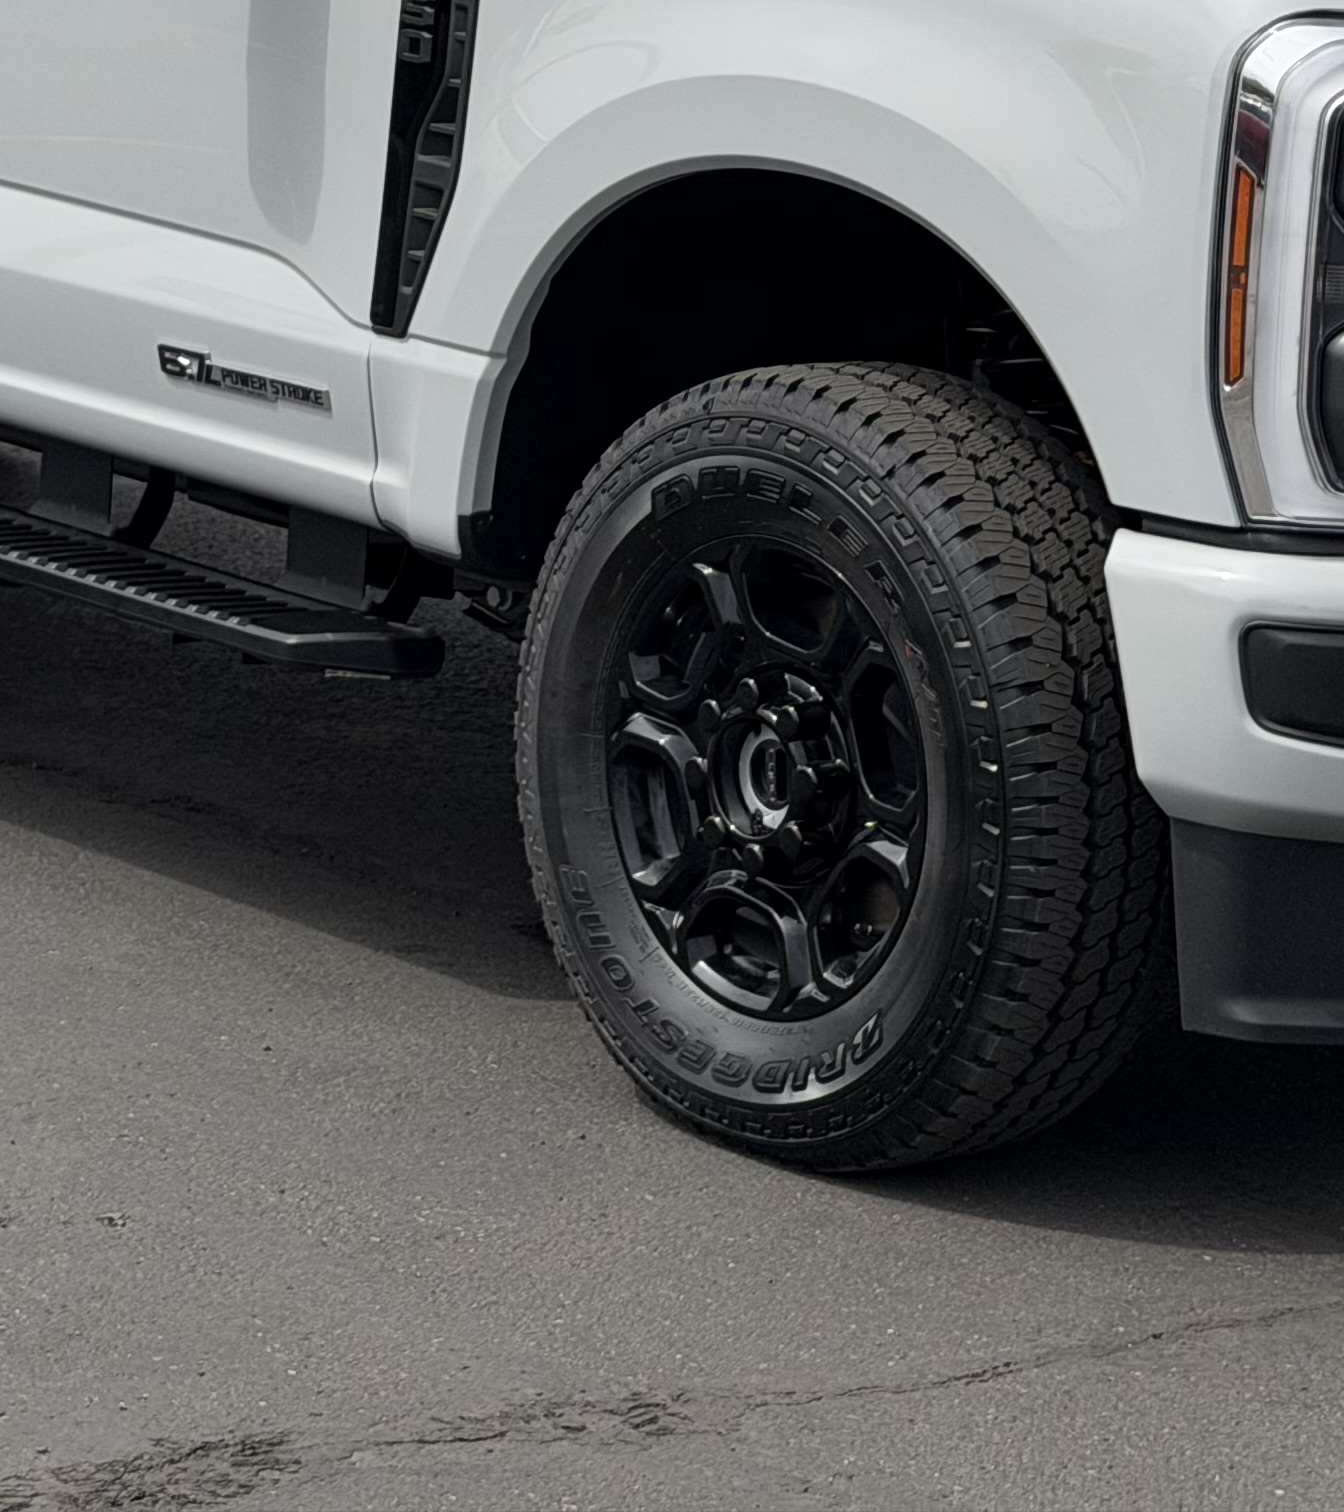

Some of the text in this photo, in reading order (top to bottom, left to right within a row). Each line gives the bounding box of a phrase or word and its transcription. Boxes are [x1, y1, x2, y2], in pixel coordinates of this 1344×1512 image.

[221, 368, 268, 391] POWER
[269, 378, 325, 407] STROKE
[650, 465, 905, 616] DUELER
[559, 863, 884, 1095] BRIDGESTONE
